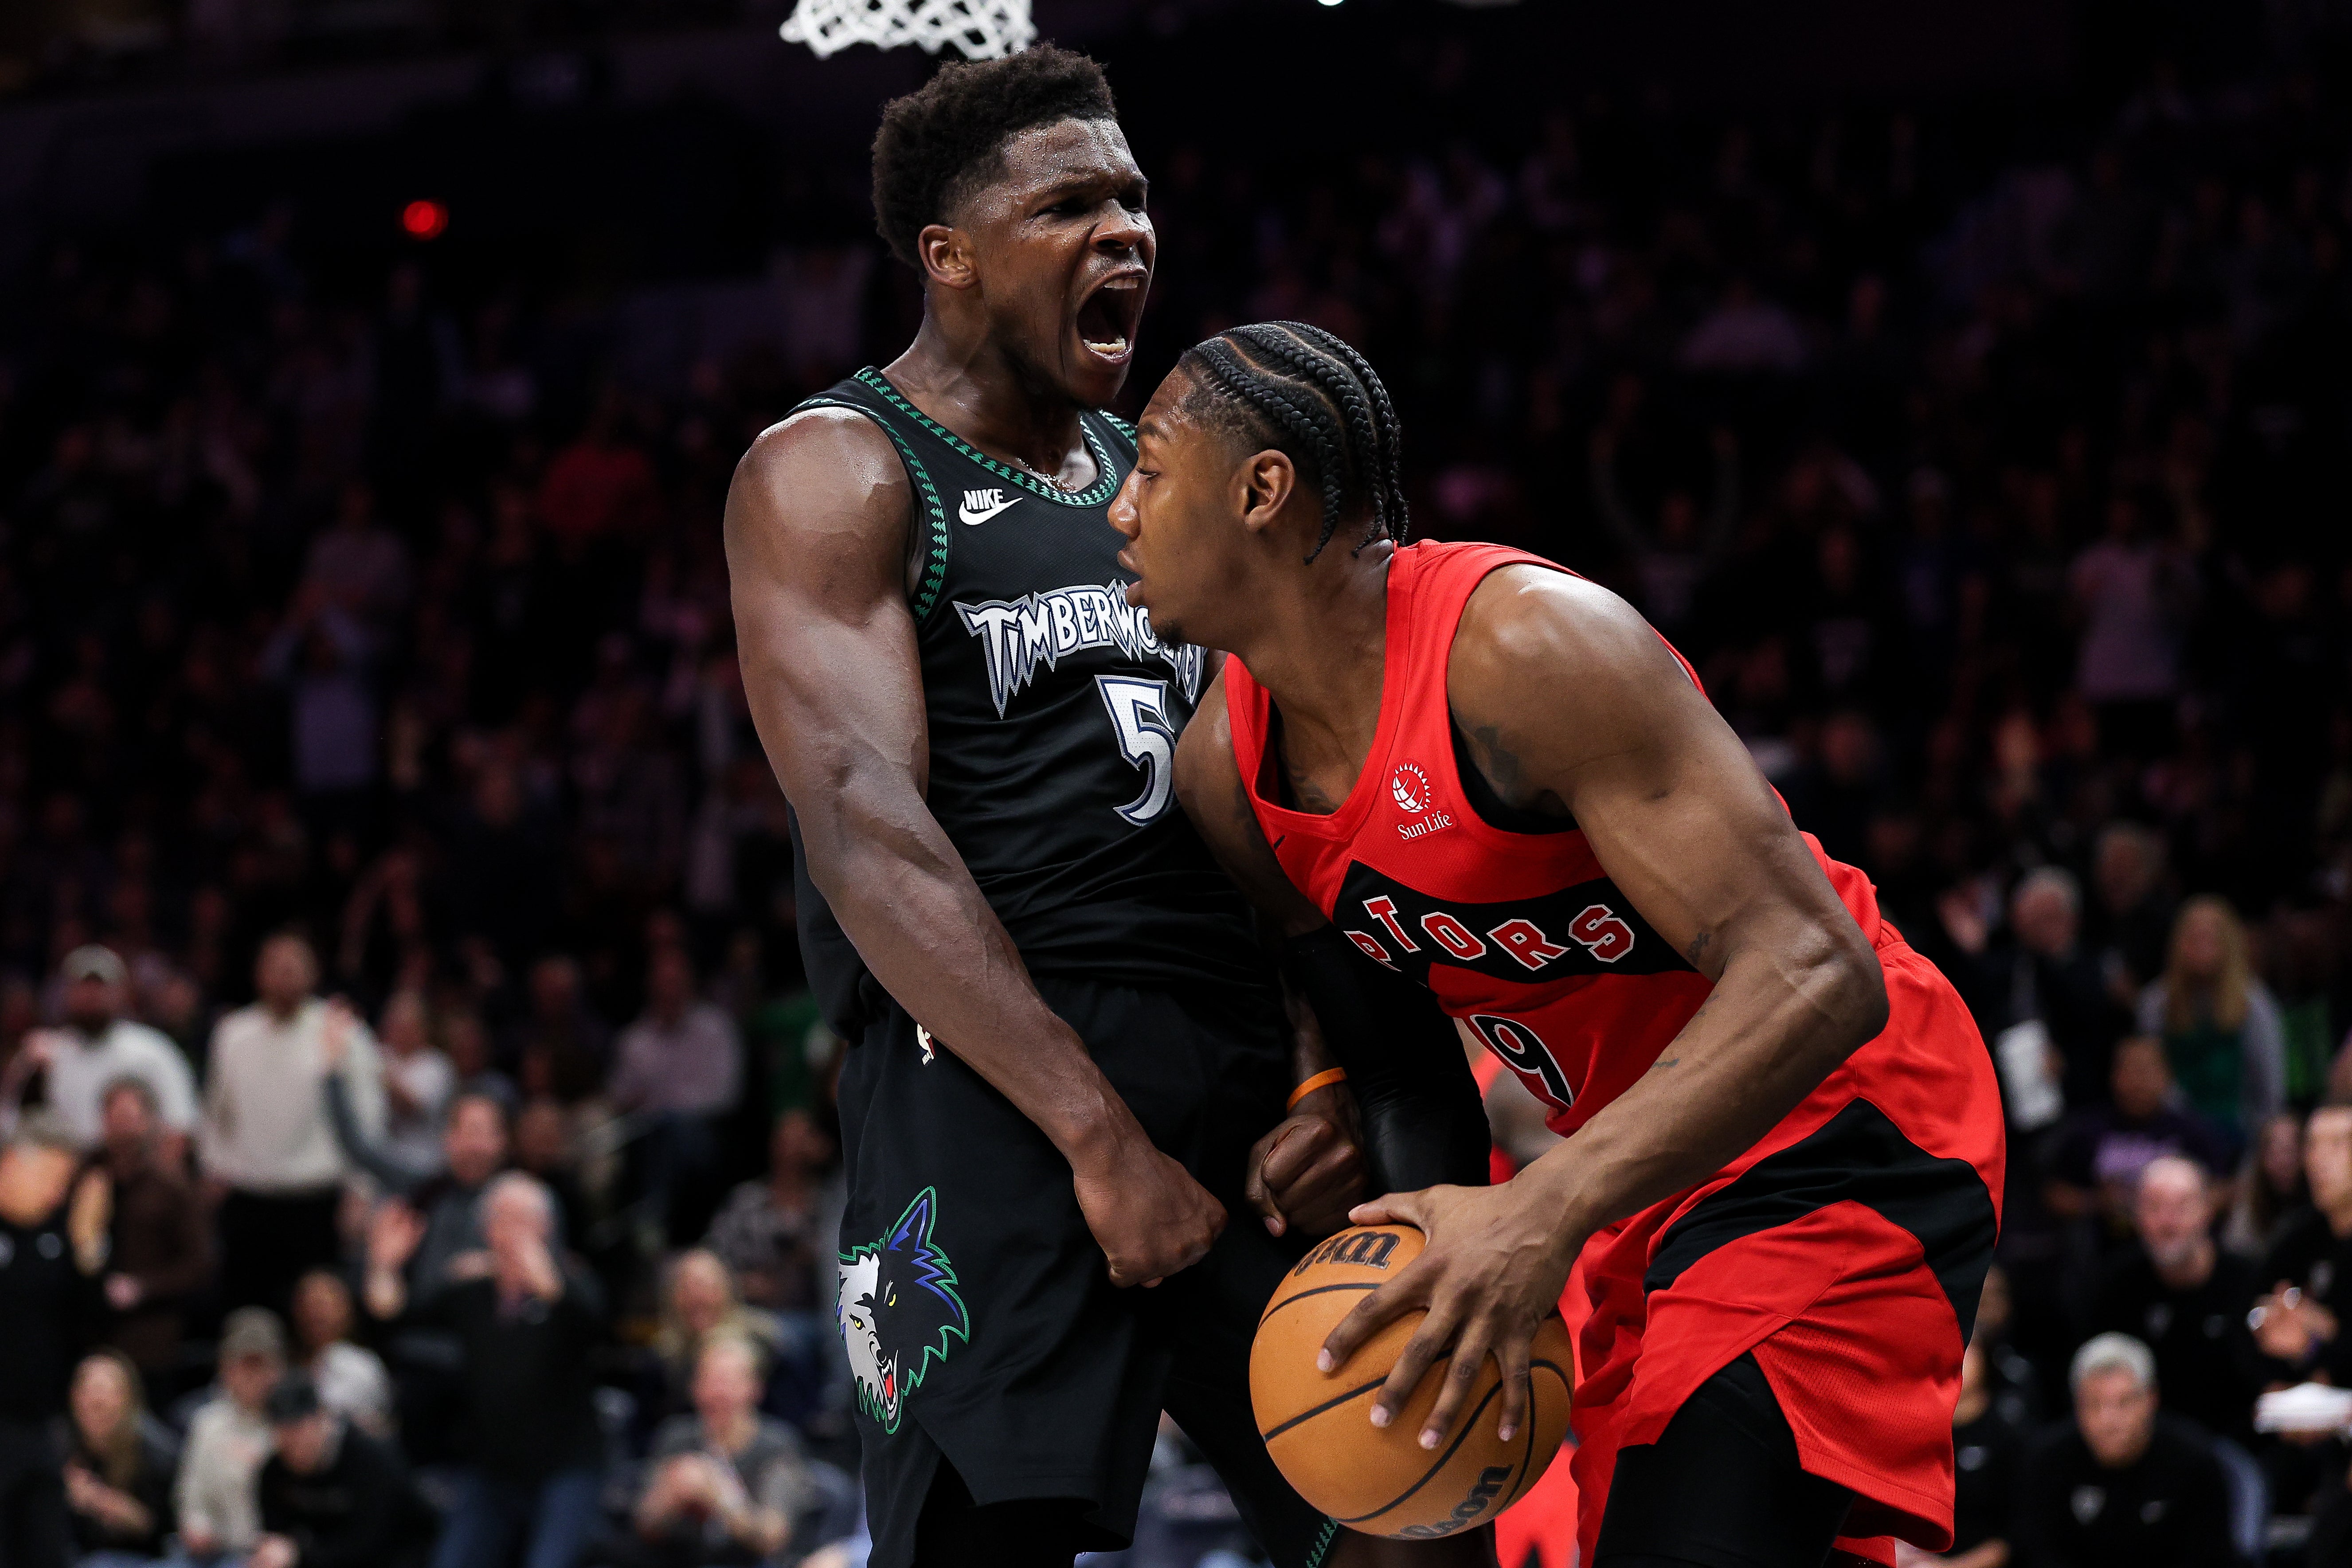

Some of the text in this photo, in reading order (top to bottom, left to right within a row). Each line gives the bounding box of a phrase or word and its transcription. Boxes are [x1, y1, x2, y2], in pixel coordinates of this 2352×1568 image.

[963, 489, 1003, 510] NIKE
[1094, 674, 1176, 827] 5
[1397, 810, 1453, 840] Sun Life
[922, 1052, 931, 1065] NBA
[1469, 1014, 1574, 1108] 9
